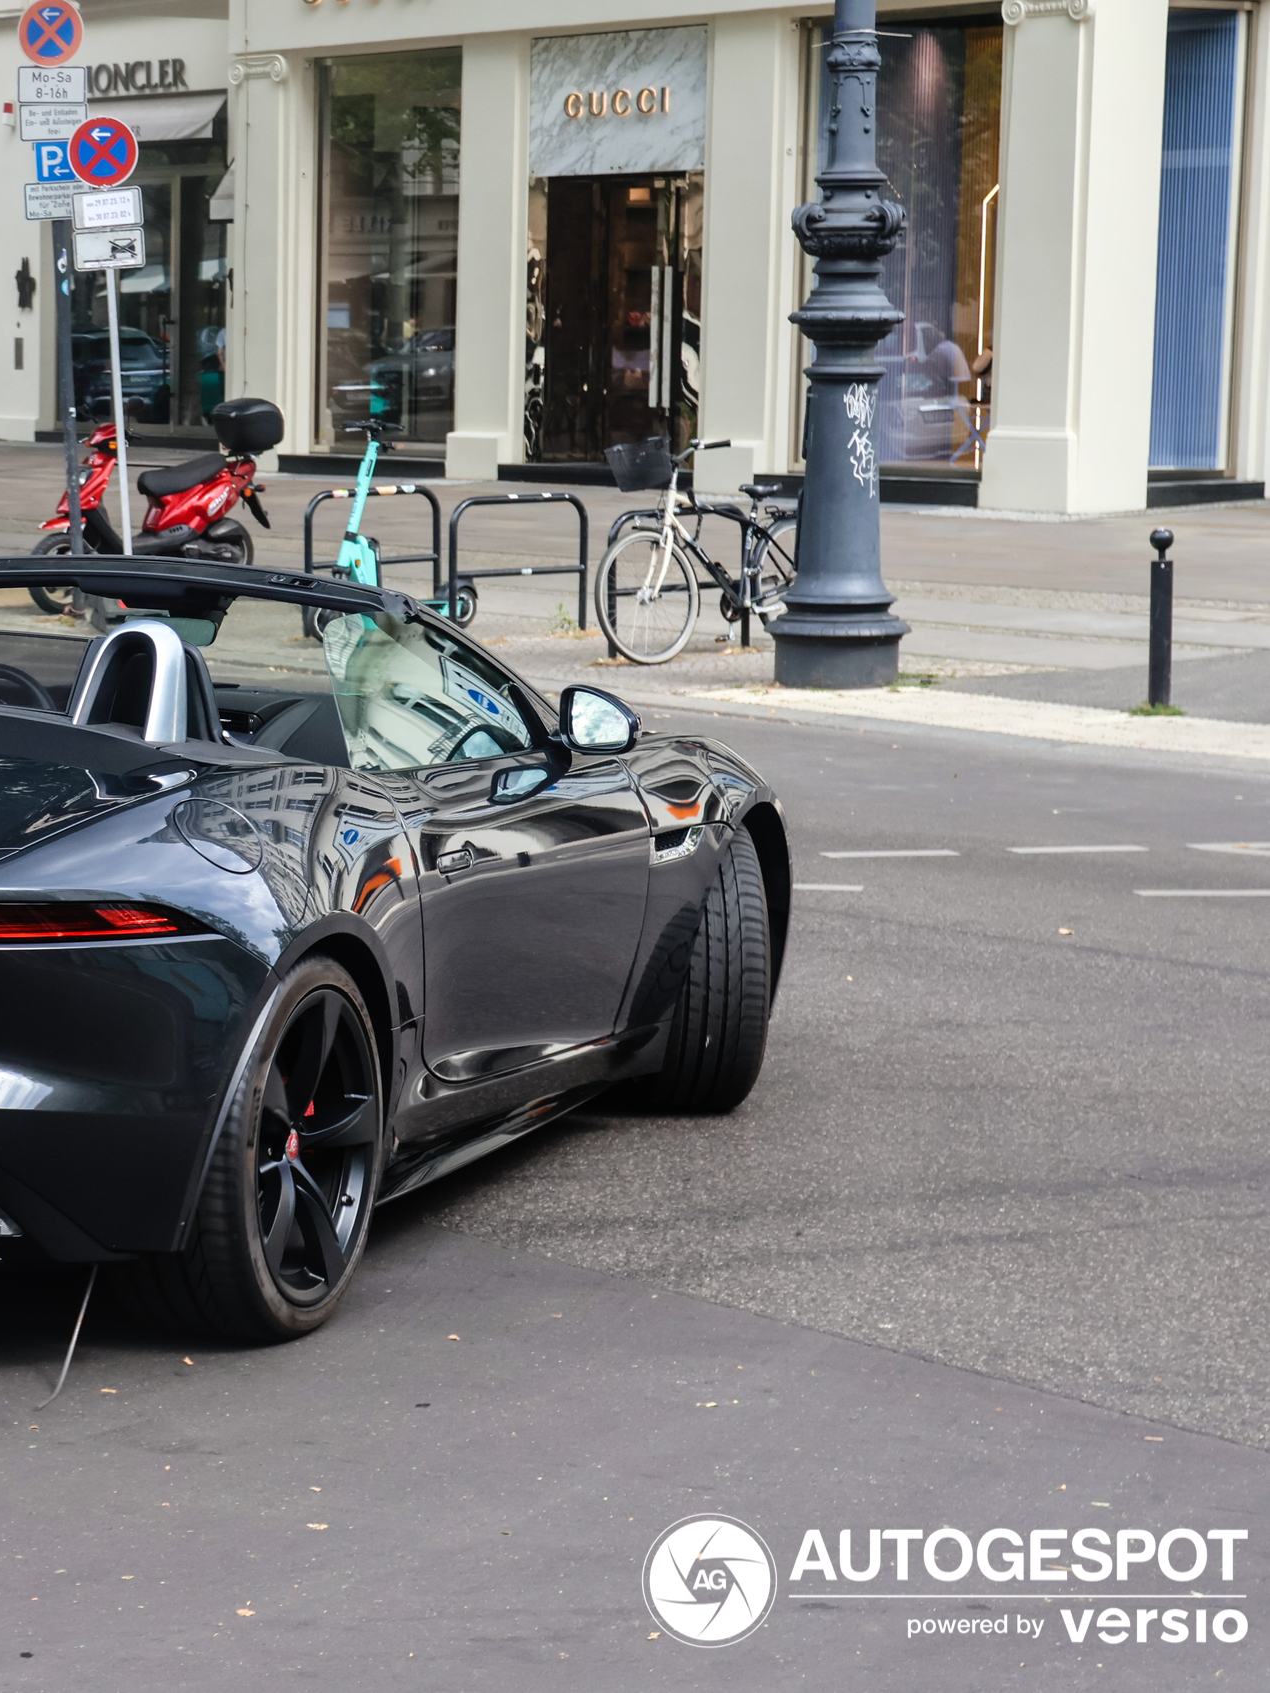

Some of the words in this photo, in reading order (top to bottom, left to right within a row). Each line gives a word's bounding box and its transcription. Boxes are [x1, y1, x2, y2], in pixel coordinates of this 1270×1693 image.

[32, 71, 71, 83] Mo-Sa
[86, 58, 188, 93] ONCLER
[36, 87, 68, 99] 8-16h
[563, 86, 670, 119] GUCCI
[41, 109, 52, 117] und
[54, 108, 78, 116] Entladen
[41, 145, 64, 178] P
[42, 184, 70, 192] Parkschein
[28, 193, 71, 202] Bewohnerparka
[29, 209, 52, 217] Mo-Sa
